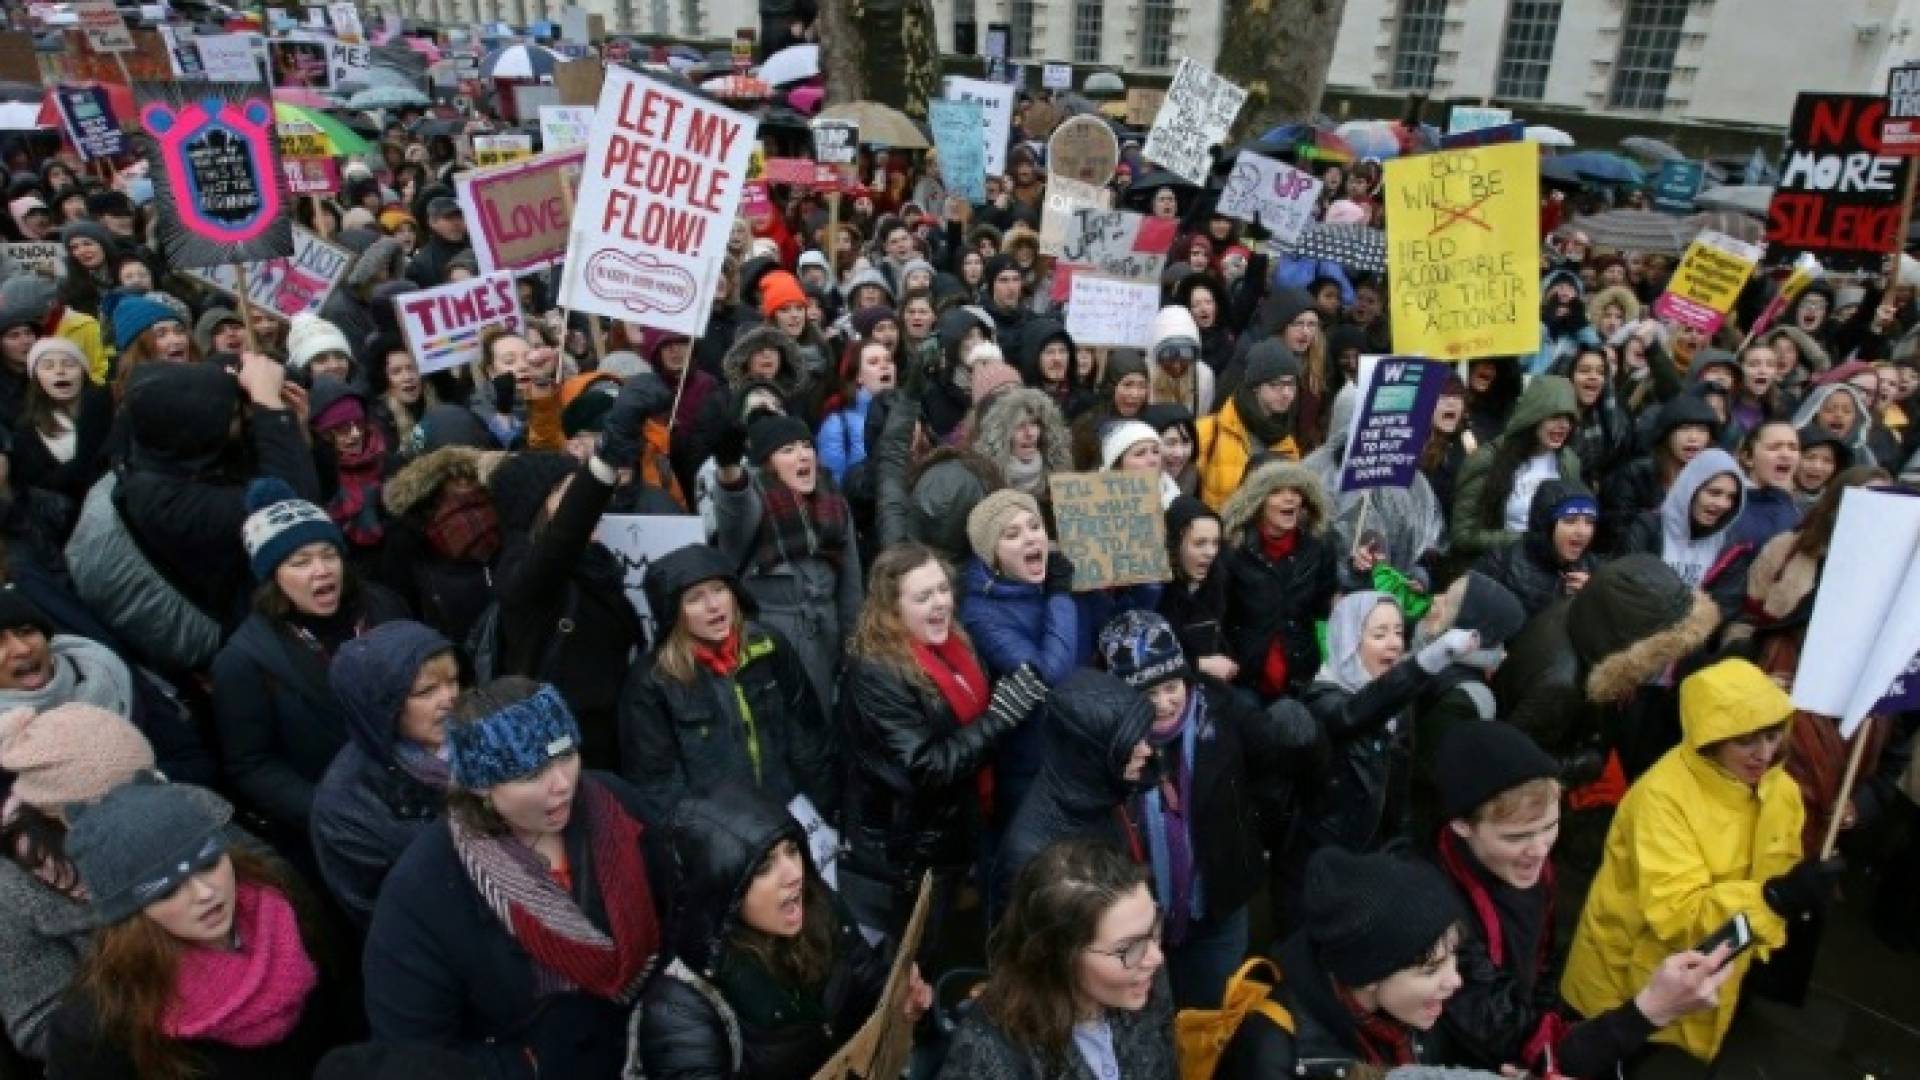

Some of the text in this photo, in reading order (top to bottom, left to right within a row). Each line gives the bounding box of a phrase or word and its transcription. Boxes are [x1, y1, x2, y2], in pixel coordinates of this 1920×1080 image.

[617, 80, 683, 143] LET
[685, 107, 741, 164] MY
[602, 133, 730, 214] PEOPLE
[1273, 170, 1313, 200] UP
[1402, 169, 1504, 210] WILL BE
[1781, 150, 1902, 192] MORE
[602, 188, 708, 257] FLOW!
[298, 239, 346, 281] NOT
[1396, 251, 1515, 292] ACCOUNTABLE
[1398, 237, 1457, 265] HELD
[405, 277, 515, 336] TIME'S
[1401, 276, 1526, 317] FOR THEIR
[1423, 300, 1517, 333] ACTIONS!
[1363, 441, 1378, 453] TO
[1094, 497, 1143, 514] WHAT
[1103, 477, 1151, 495] TELL
